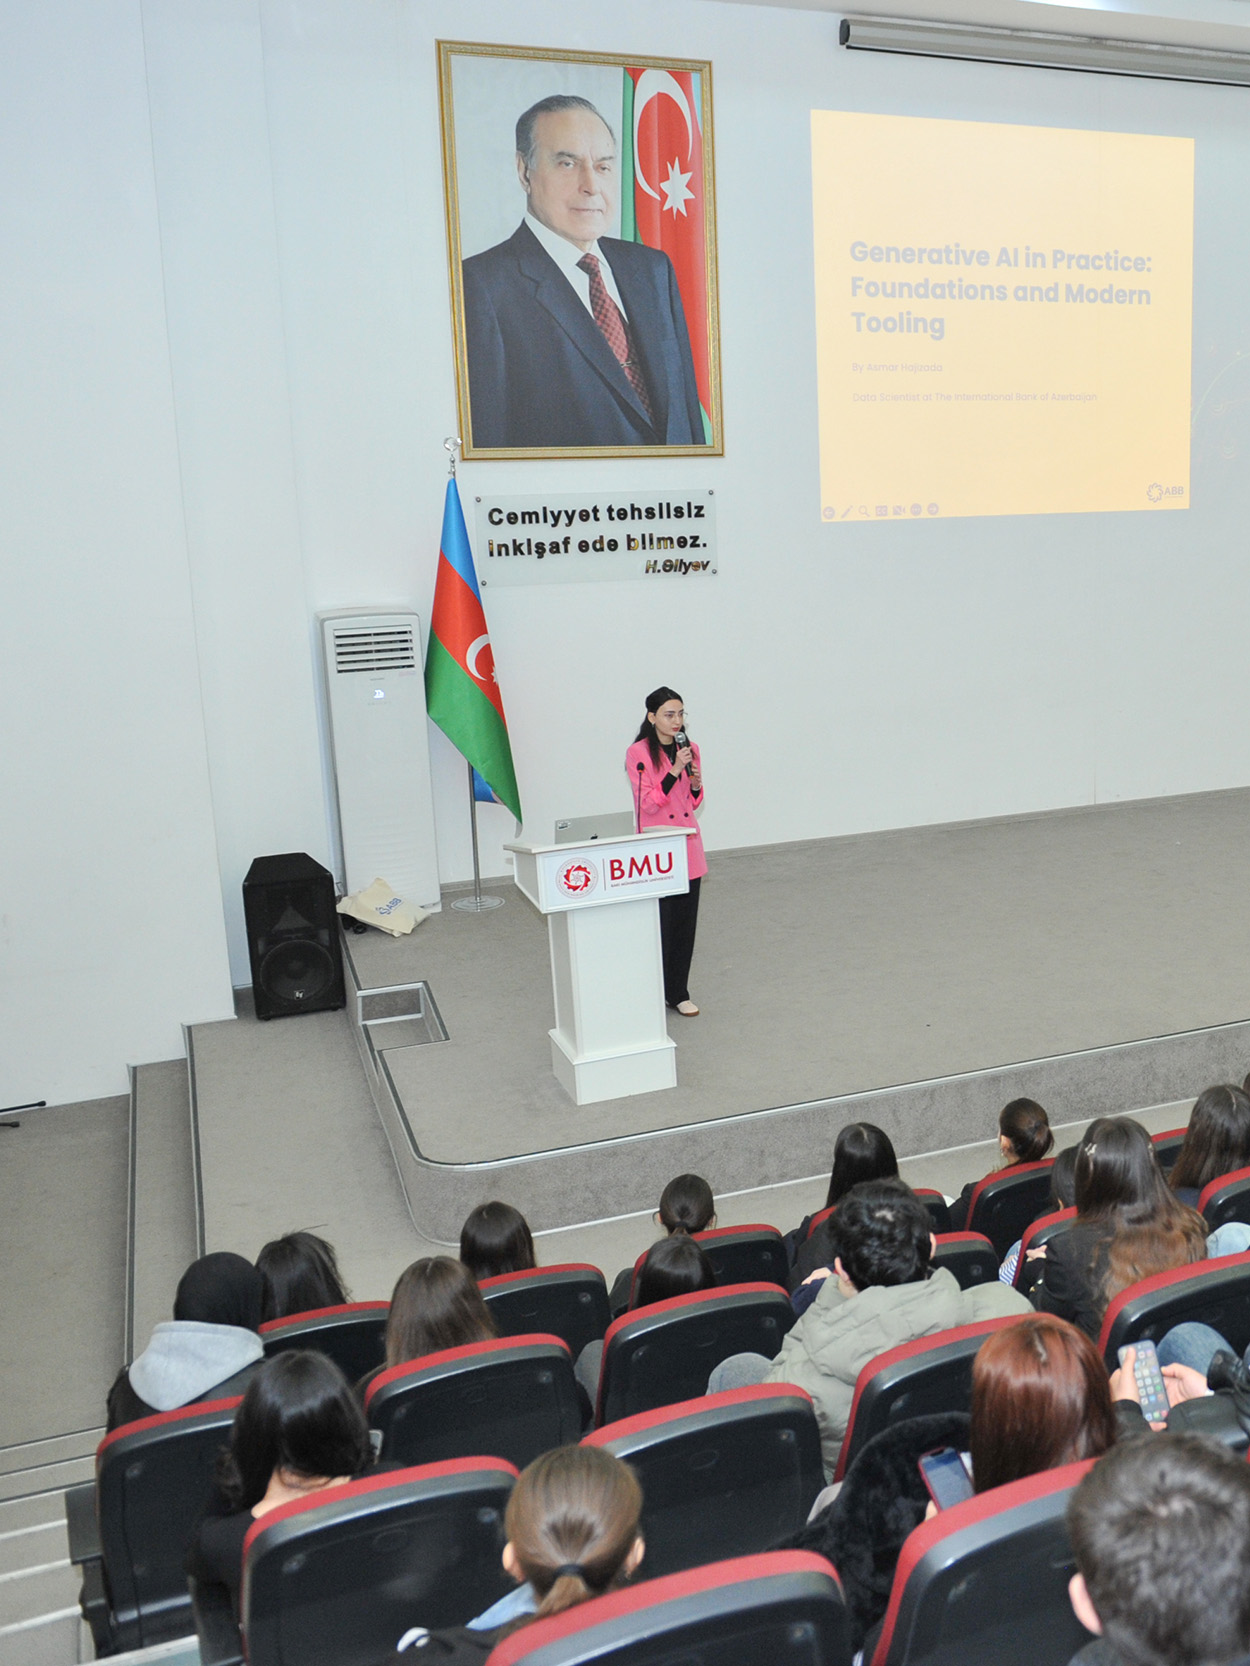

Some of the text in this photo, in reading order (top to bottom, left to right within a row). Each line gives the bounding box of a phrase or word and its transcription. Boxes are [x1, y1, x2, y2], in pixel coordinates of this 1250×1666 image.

[850, 241, 1152, 273] Generative AI in Practice:
[850, 276, 1151, 306] Foundations and Modern
[850, 311, 945, 340] Tooling
[851, 362, 864, 375] By
[866, 362, 898, 373] Asmar
[852, 392, 877, 403] Data
[879, 392, 920, 404] Scientist
[922, 393, 933, 404] at
[934, 392, 952, 404] The
[953, 392, 1013, 404] International
[1016, 392, 1038, 404] Bank
[1040, 391, 1049, 404] of
[1165, 486, 1184, 495] ABB
[488, 536, 571, 559] inkişaf
[609, 851, 673, 881] BMU
